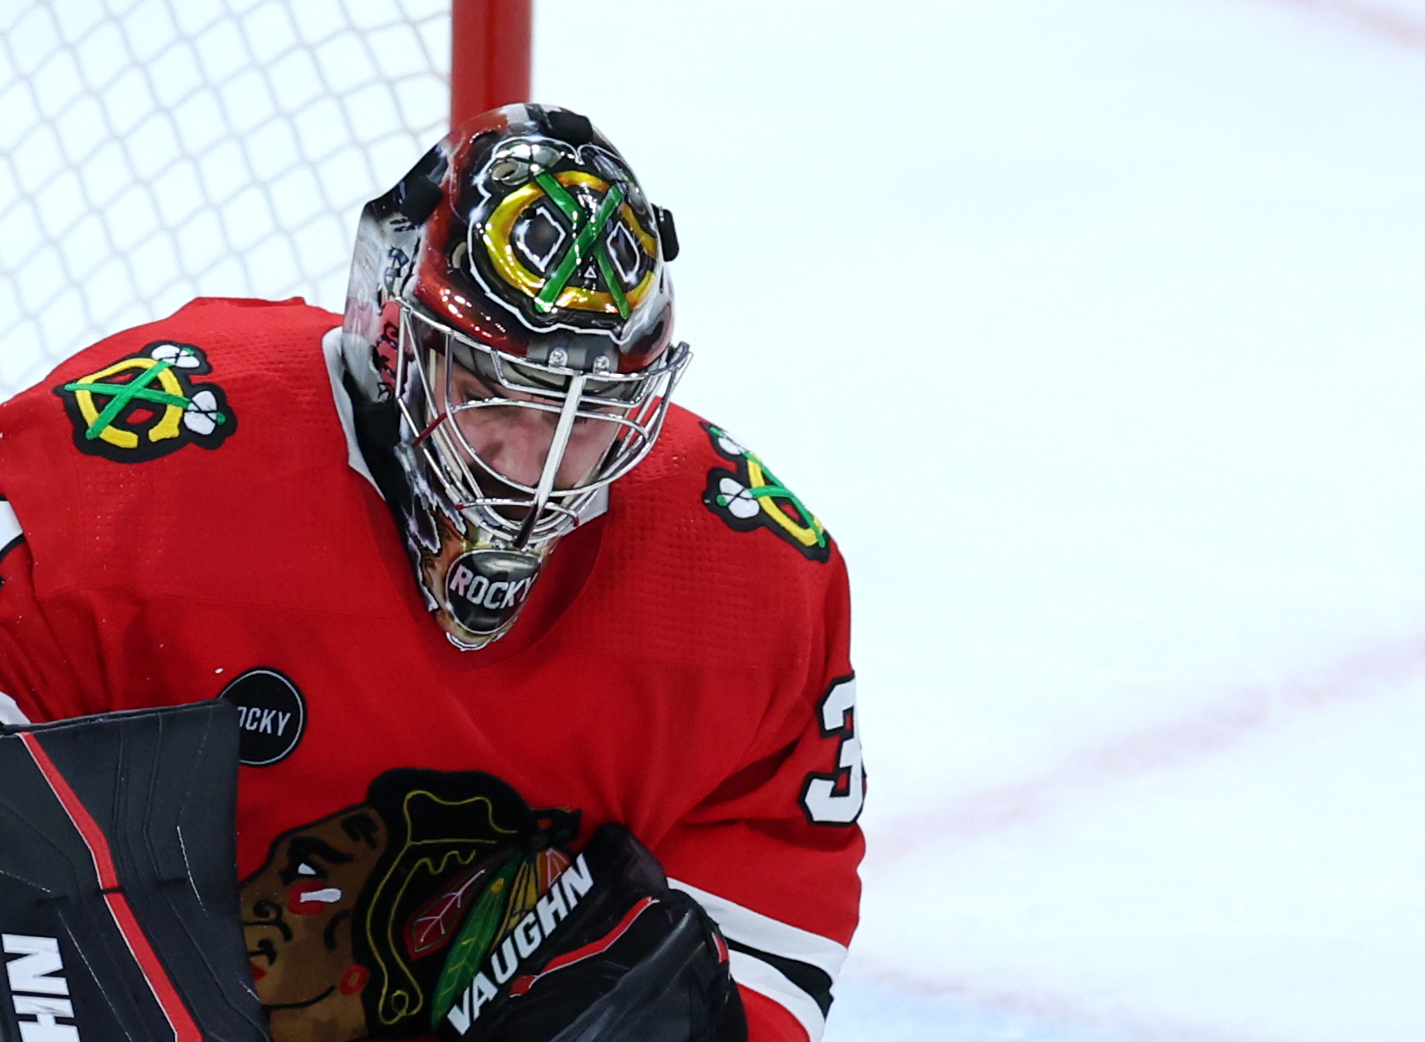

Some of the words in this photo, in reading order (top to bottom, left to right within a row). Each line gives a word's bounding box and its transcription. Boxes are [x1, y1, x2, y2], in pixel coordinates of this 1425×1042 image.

[449, 563, 539, 610] ROCKY
[237, 705, 292, 737] OCKY
[447, 852, 595, 1037] VAUGHN
